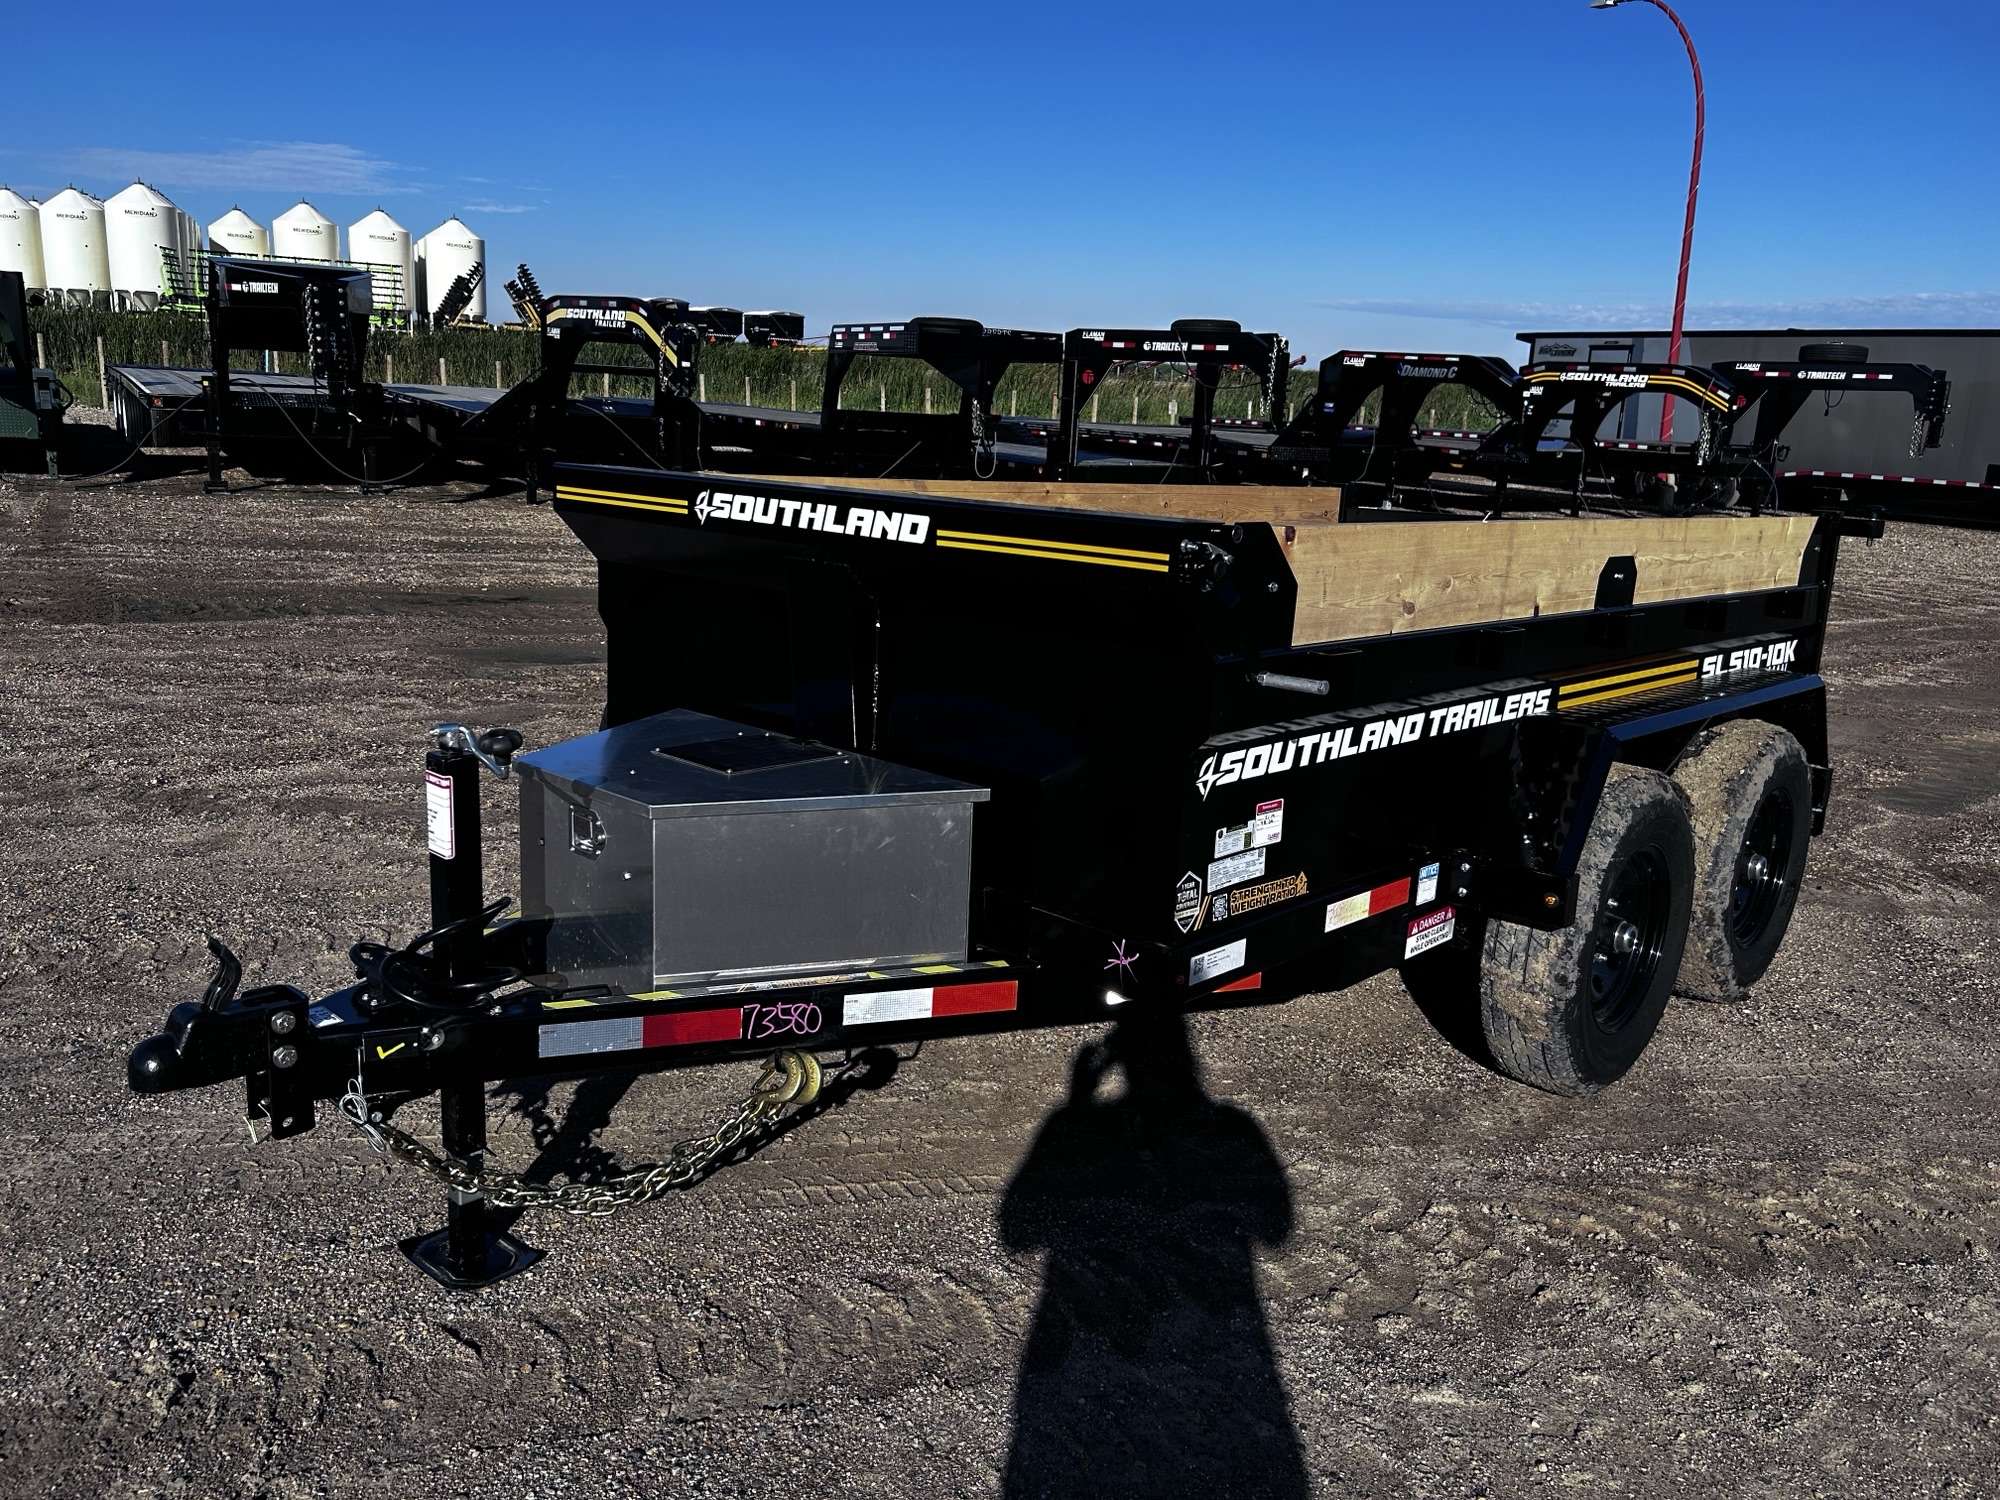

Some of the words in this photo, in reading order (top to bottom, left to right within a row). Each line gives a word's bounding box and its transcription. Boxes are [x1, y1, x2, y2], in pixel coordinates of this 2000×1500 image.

[248, 281, 279, 294] TRAILTECH
[566, 308, 626, 321] SOUTHLAND
[594, 319, 626, 329] TRAILERS
[1401, 364, 1447, 378] DIAMOND
[1448, 366, 1459, 379] C
[1565, 372, 1650, 384] SOUTHLAND
[1805, 370, 1847, 380] TRAILTECH
[1604, 381, 1647, 389] TRAILERS
[709, 491, 931, 545] SOUTHLAND
[1214, 711, 1427, 788] SOUTHLAND
[1427, 687, 1553, 738] TRAILERS
[1177, 889, 1199, 903] TOTAL
[1230, 893, 1269, 916] WEIGHT
[1268, 884, 1298, 905] RATIO
[1419, 911, 1446, 931] DANGER
[1415, 931, 1431, 943] STAND
[743, 1001, 823, 1040] 73580
